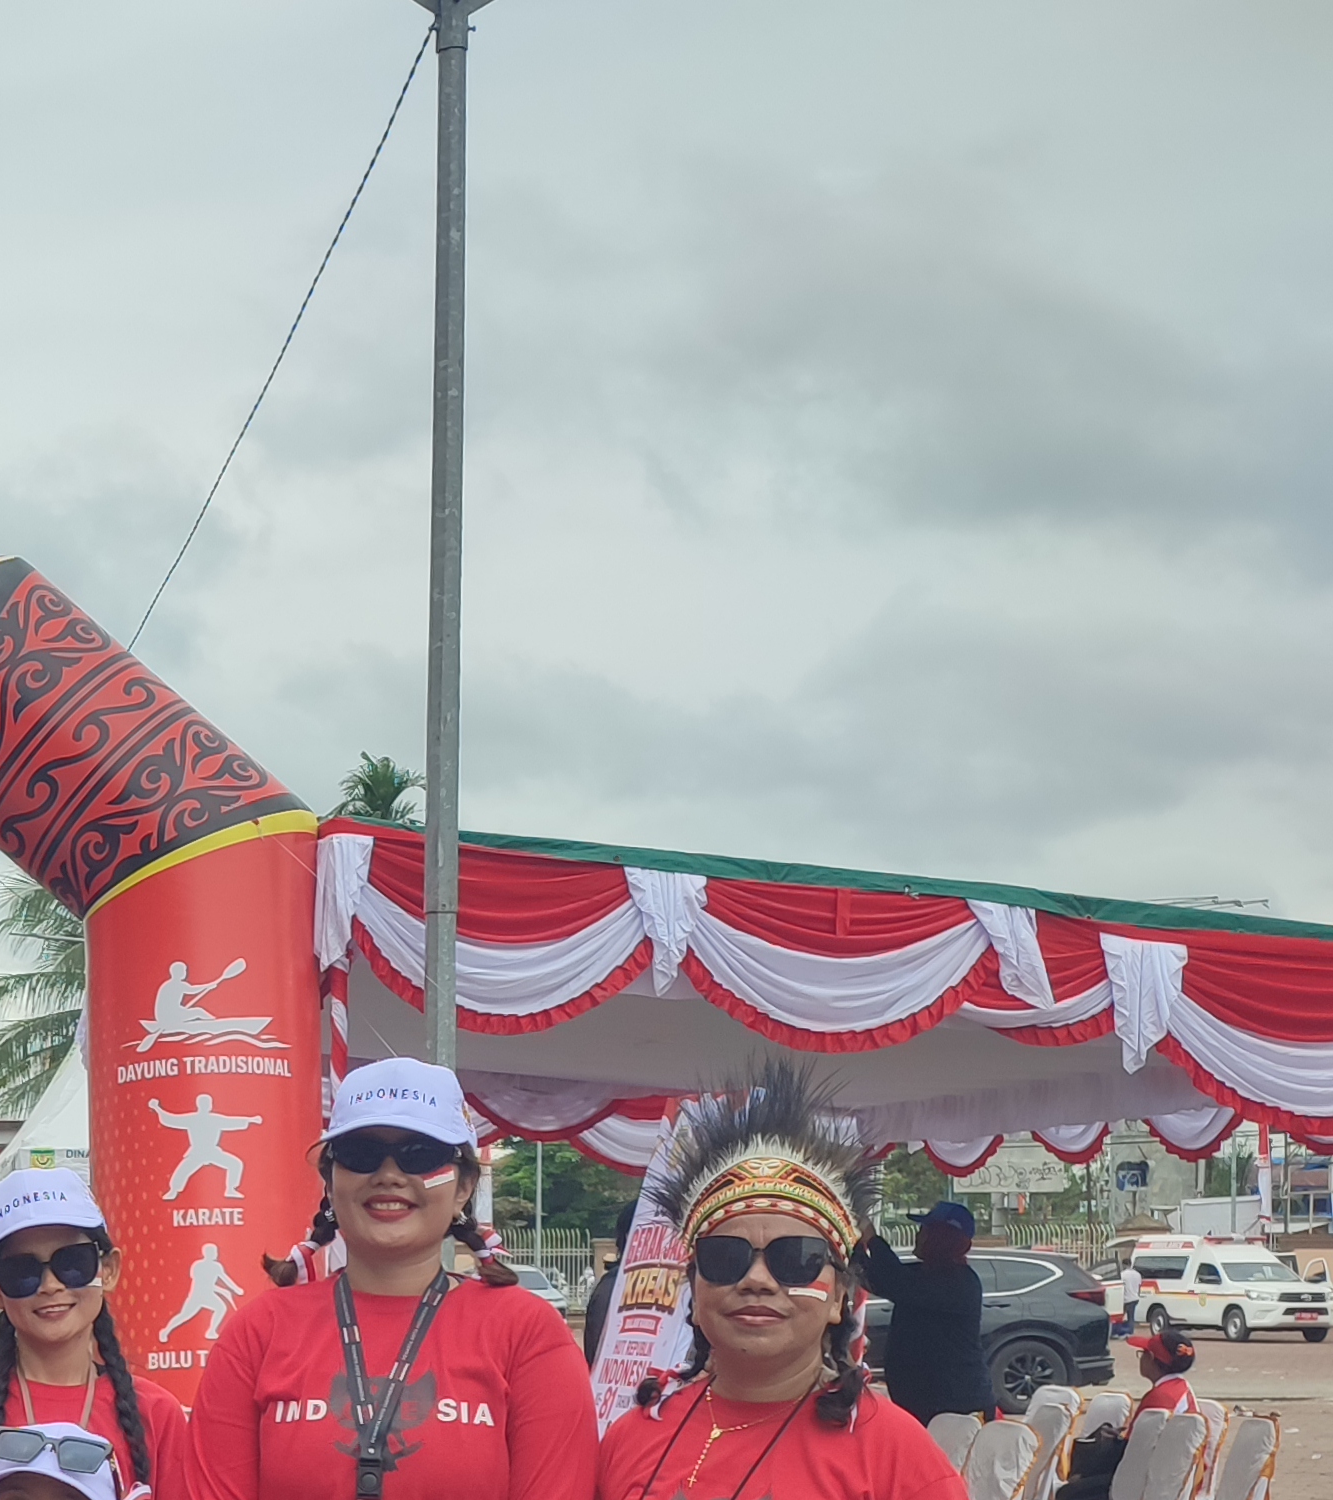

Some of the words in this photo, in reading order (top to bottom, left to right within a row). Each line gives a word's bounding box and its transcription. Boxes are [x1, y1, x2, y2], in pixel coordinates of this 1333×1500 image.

[117, 1057, 180, 1085] DAYUNG
[184, 1055, 292, 1078] TRADISIONAL
[349, 1087, 438, 1108] INDONESIA
[172, 1207, 244, 1227] KARATE
[147, 1350, 192, 1370] BULU
[599, 1386, 619, 1420] 81
